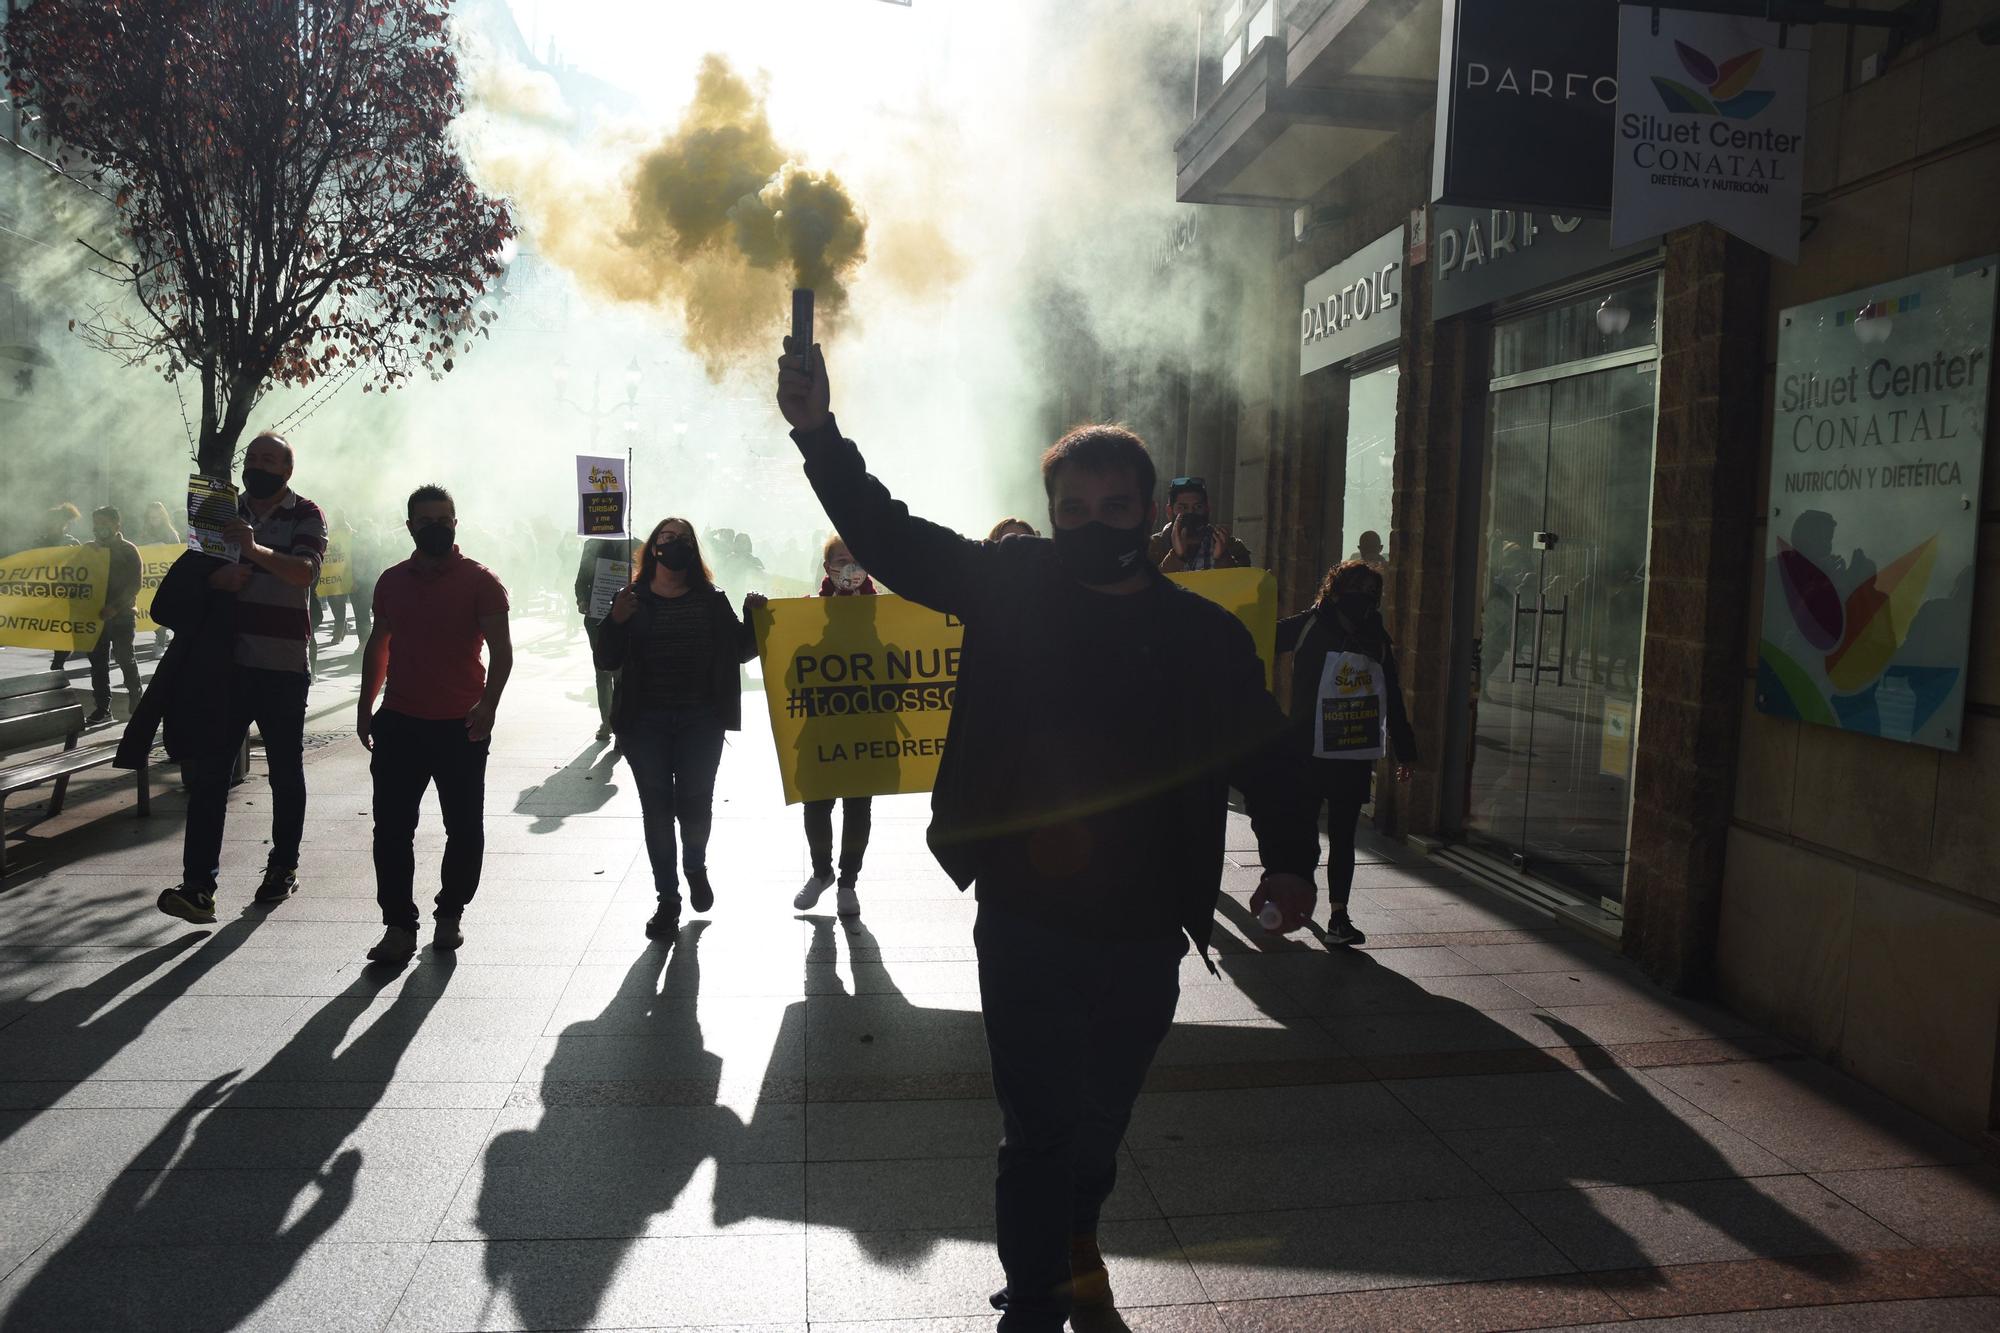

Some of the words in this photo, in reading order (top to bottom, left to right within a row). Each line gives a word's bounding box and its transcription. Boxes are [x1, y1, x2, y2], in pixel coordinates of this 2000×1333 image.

[1621, 113, 1700, 145] Siluet
[1709, 121, 1802, 153] Center
[1633, 142, 1785, 181] CONATAL
[1651, 172, 1700, 189] DIETÉTICA
[1702, 179, 1711, 190] Y
[1712, 178, 1769, 194] NUTRICIÓN
[1302, 262, 1399, 345] PARFOIS
[1782, 366, 1859, 413] Siluet
[1867, 351, 1984, 400] Center
[1792, 403, 1960, 453] CONATAL
[1784, 463, 1862, 493] NUTRICIÓN
[1866, 467, 1879, 489] Y
[1881, 458, 1962, 489] DIETÉTICA
[588, 504, 618, 513] TURISMO
[9, 566, 89, 582] FUTURO
[796, 653, 875, 684] POR
[817, 744, 848, 762] LA
